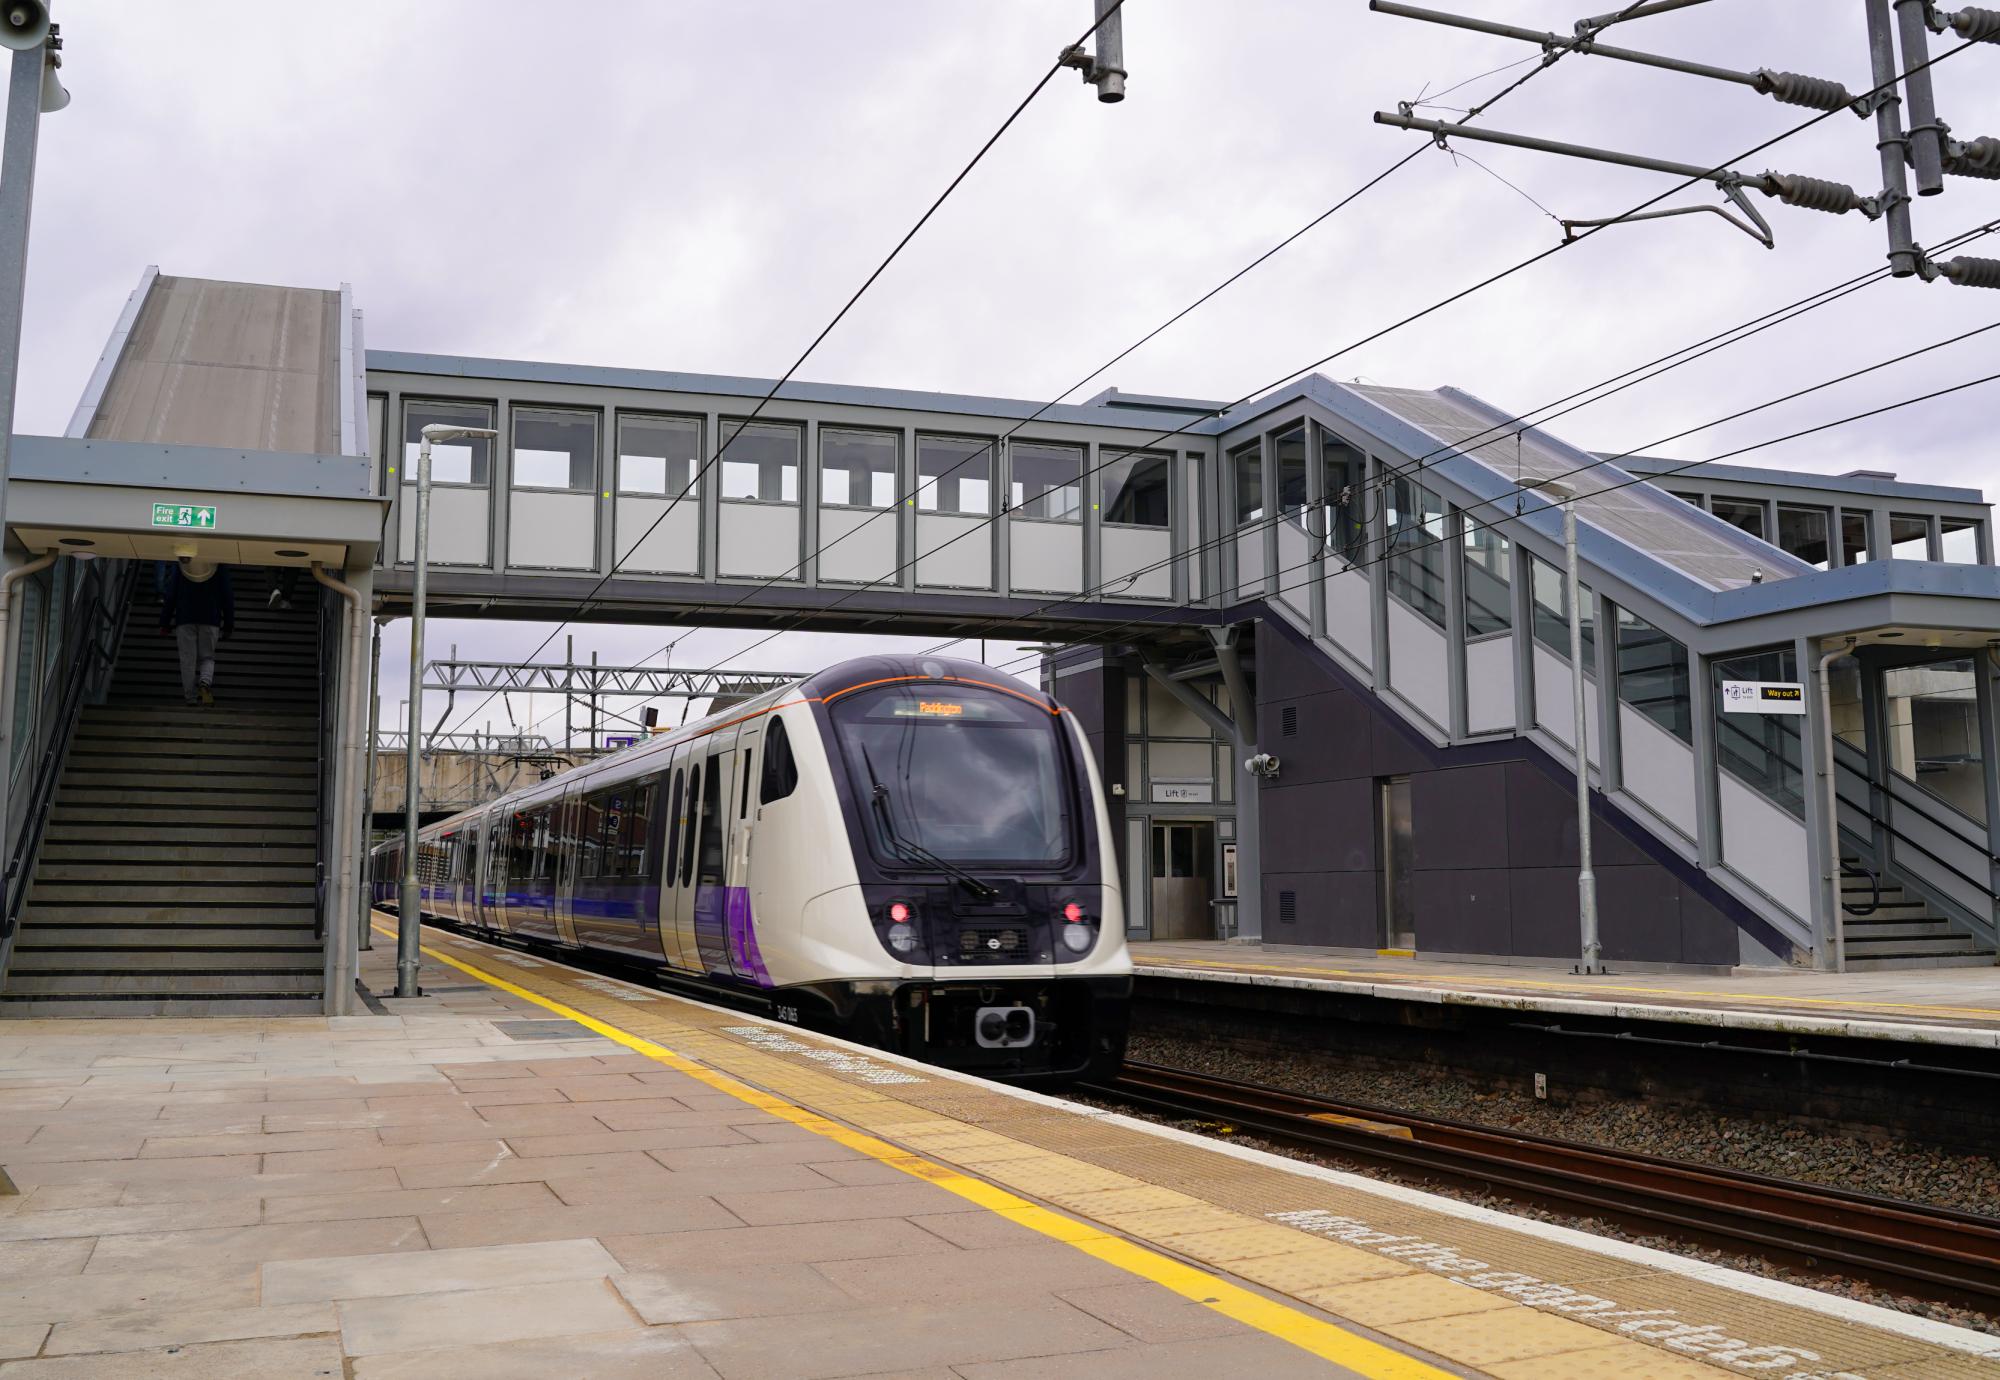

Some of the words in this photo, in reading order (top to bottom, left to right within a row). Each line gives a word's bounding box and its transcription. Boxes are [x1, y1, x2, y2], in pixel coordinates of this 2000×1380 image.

[156, 506, 174, 515] Fire
[156, 515, 173, 523] exit
[1742, 687, 1754, 695] Lift
[1767, 689, 1781, 698] Way
[919, 701, 962, 716] Paddington
[1165, 789, 1180, 798] Lift
[1264, 1208, 1423, 1246] Mind
[1377, 1242, 1490, 1272] the
